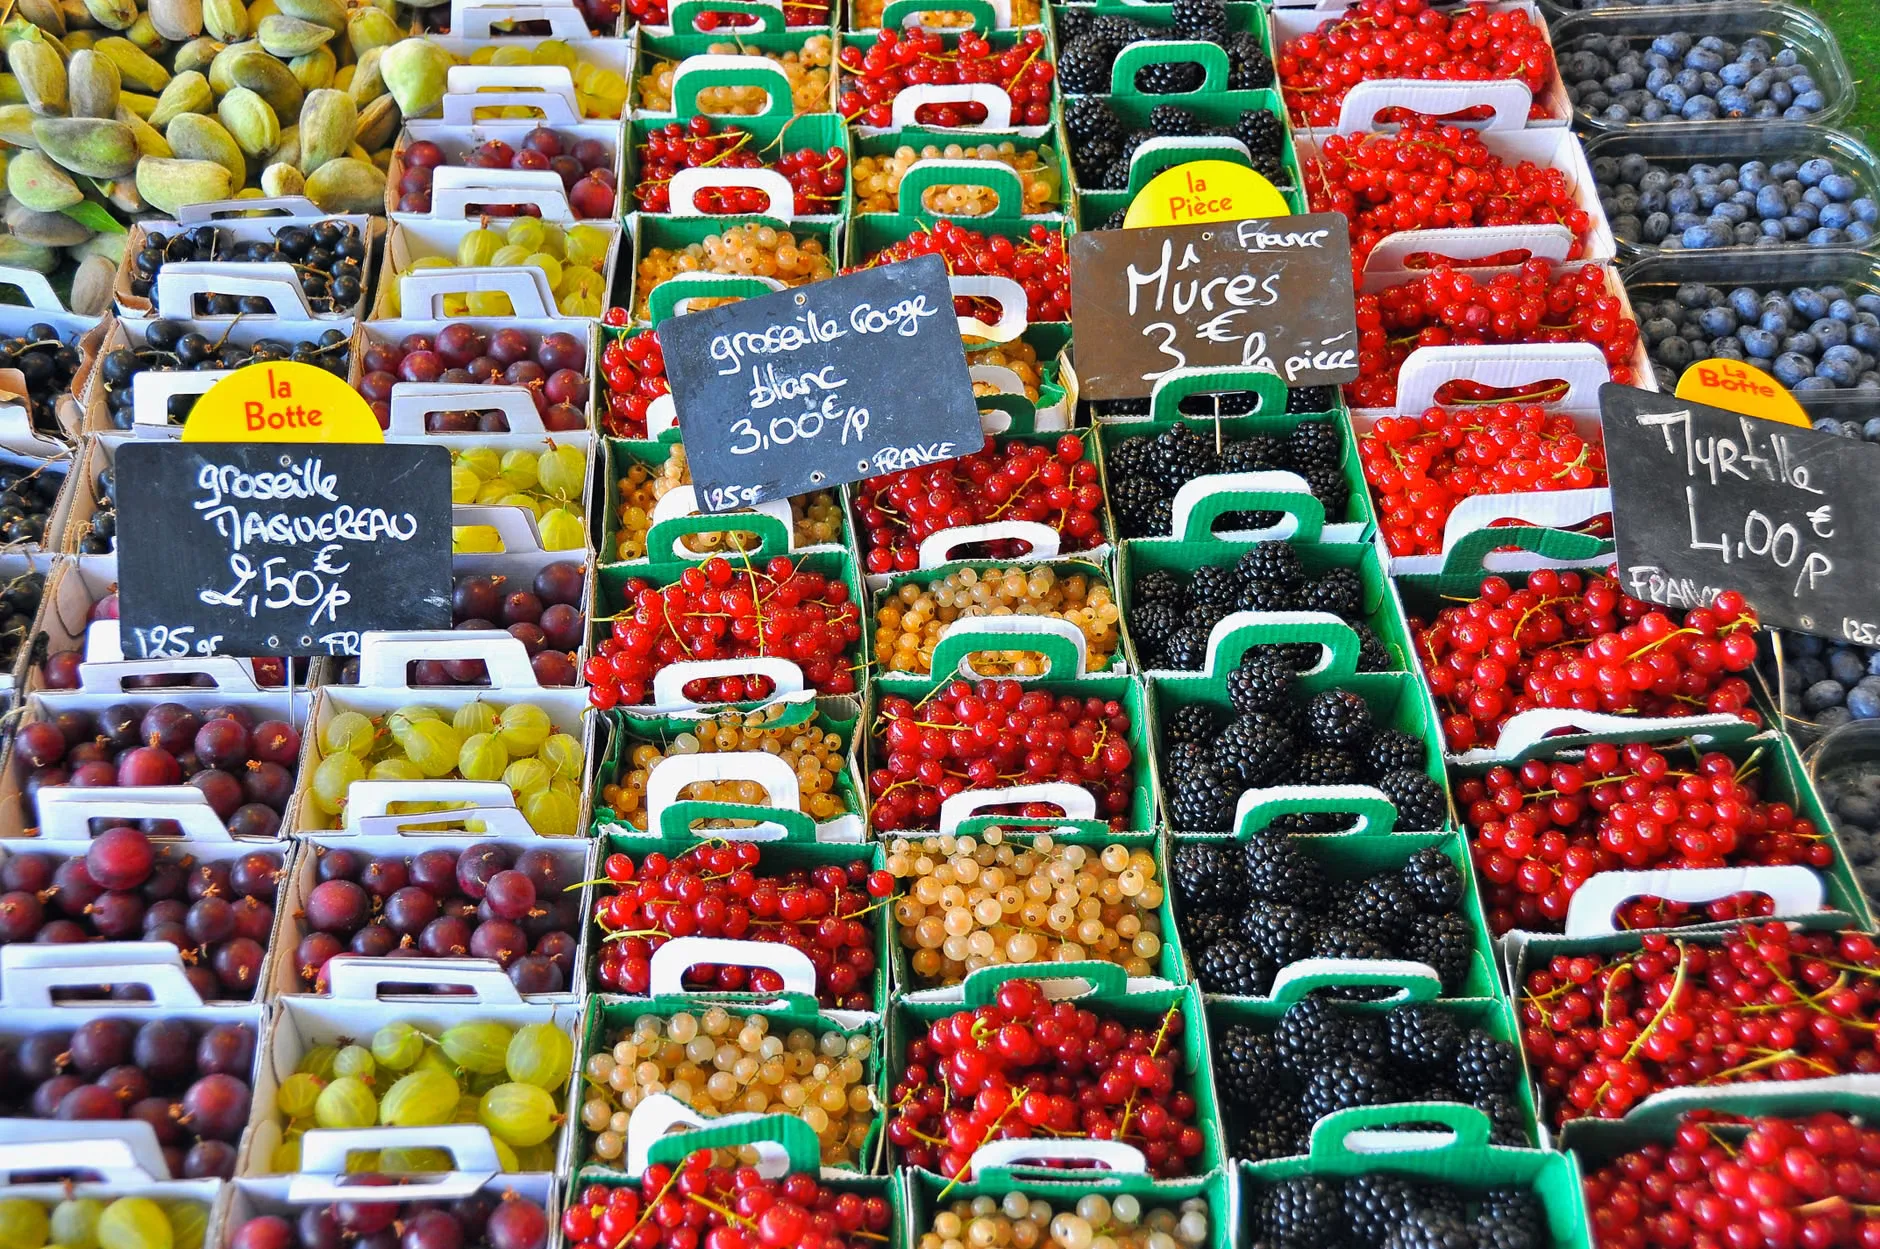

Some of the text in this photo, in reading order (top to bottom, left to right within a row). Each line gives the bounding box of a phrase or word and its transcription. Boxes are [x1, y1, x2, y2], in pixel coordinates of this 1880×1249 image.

[1186, 170, 1207, 194] la
[1169, 195, 1233, 220] Pièce
[1126, 238, 1280, 316] Mûres
[267, 368, 292, 400] la
[748, 362, 848, 409] blanc
[1697, 367, 1776, 398] Botte
[1721, 364, 1747, 380] La
[244, 401, 323, 431] Botte
[873, 443, 956, 474] FRANCE
[194, 457, 339, 510] groseille
